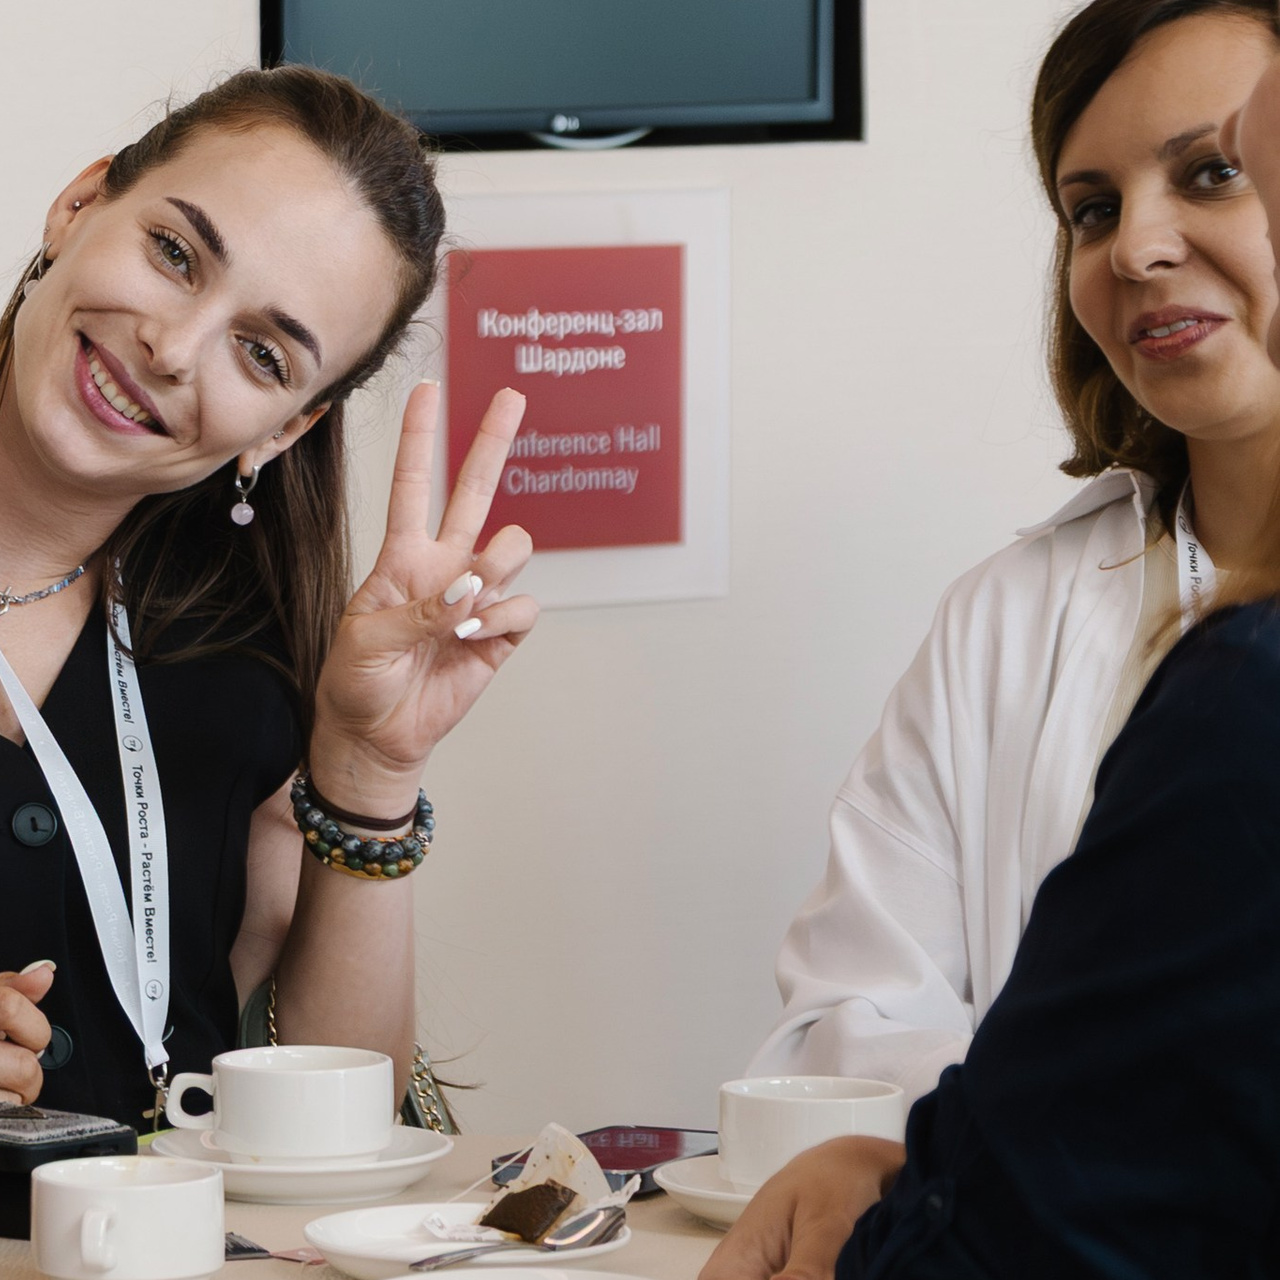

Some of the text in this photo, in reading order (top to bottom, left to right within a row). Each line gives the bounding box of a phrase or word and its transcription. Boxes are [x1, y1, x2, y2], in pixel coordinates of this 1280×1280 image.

[478, 306, 663, 341] Конференц-зал
[515, 343, 626, 377] Шардоне
[507, 424, 660, 459] onference Hall
[505, 466, 639, 495] Chardonnay
[1187, 541, 1198, 573] Точки
[113, 643, 124, 677] астём
[118, 679, 135, 724] Вместе!
[132, 765, 145, 799] Точки
[137, 802, 149, 839] Роста
[142, 851, 153, 903] Растём
[144, 907, 157, 963] Вместе!
